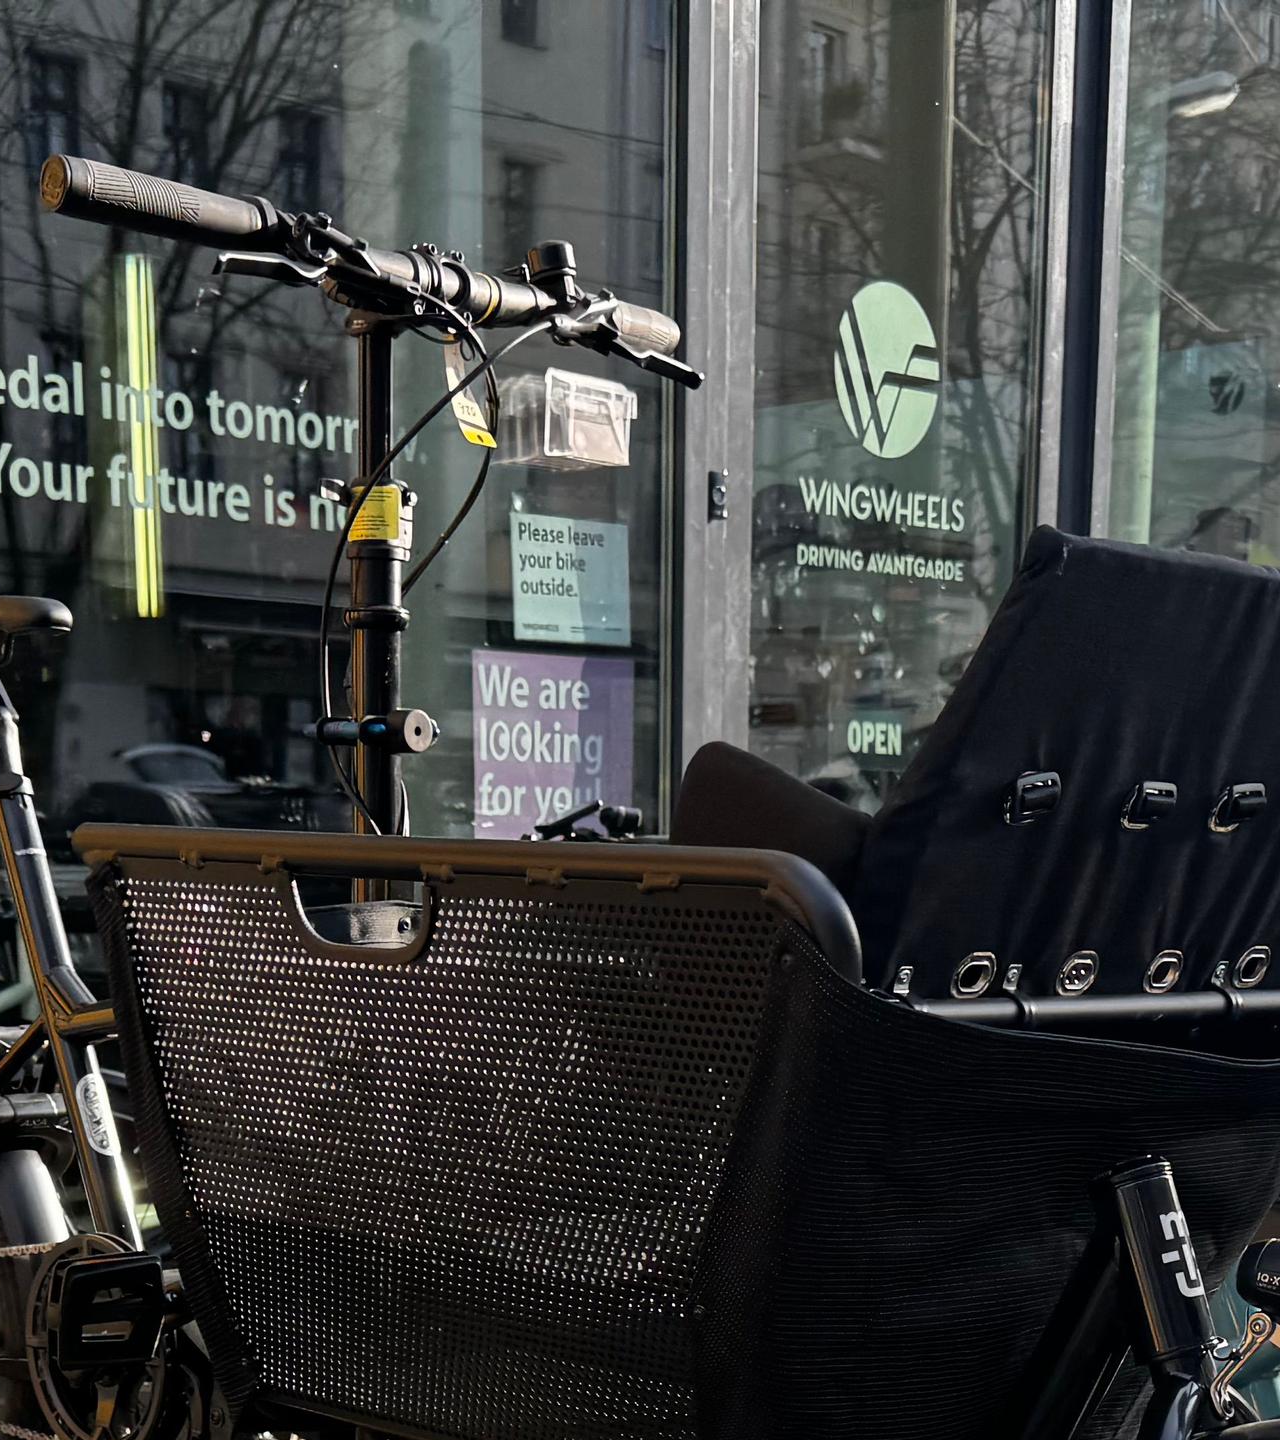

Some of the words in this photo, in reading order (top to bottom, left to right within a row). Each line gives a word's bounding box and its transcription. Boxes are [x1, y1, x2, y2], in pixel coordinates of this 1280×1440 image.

[99, 365, 194, 430] into
[106, 453, 251, 523] future
[263, 473, 297, 528] is
[798, 475, 966, 533] WINGWHEELS
[518, 522, 564, 544] Please
[568, 525, 605, 547] leave
[519, 553, 552, 572] your
[556, 551, 586, 573] bike
[796, 542, 864, 572] DRIVING
[866, 552, 965, 583] AVANTGARDE
[520, 577, 578, 598] outside.
[478, 663, 530, 709] We
[538, 677, 590, 711] are
[479, 717, 604, 775] looking
[847, 719, 902, 756] OPEN
[479, 772, 527, 817] for
